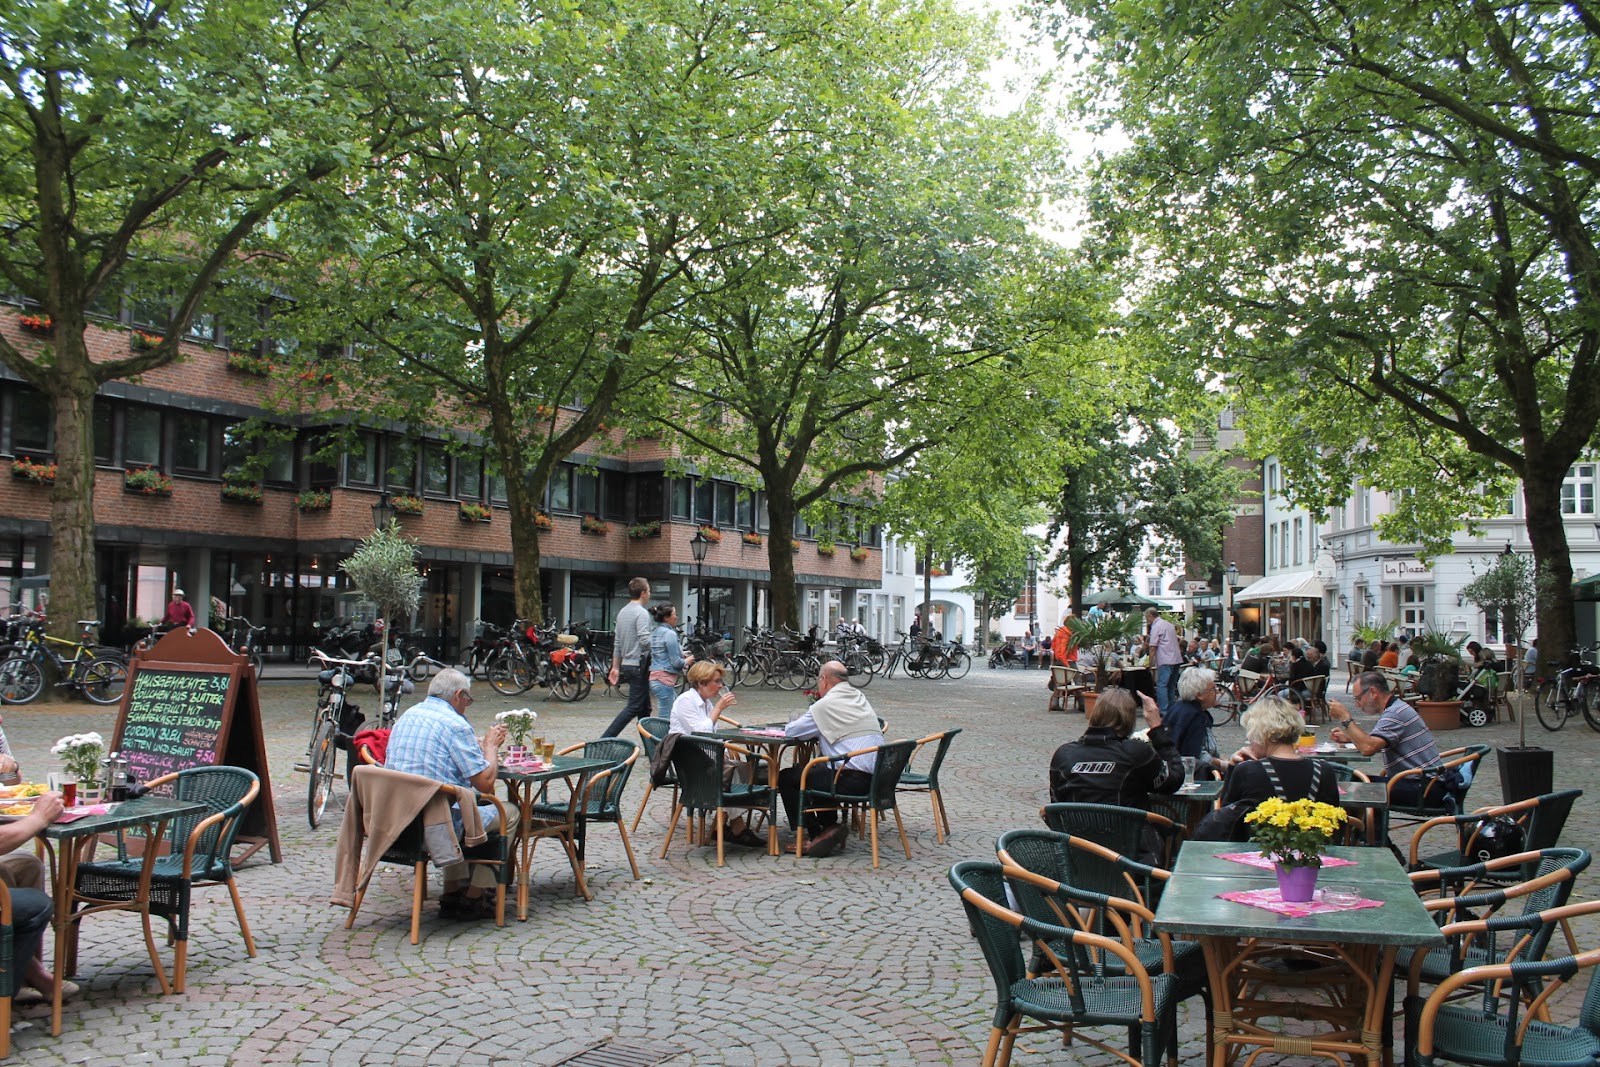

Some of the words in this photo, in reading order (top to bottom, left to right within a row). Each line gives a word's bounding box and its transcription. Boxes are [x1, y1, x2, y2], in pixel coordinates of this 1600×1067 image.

[1385, 564, 1397, 574] La
[135, 672, 209, 690] HAUSGEMACHTE
[170, 691, 188, 702] AUS
[187, 704, 204, 715] MIT
[124, 725, 158, 739] CORDON
[158, 728, 182, 743] BLEU
[153, 743, 170, 753] UND
[169, 745, 196, 757] SALAT
